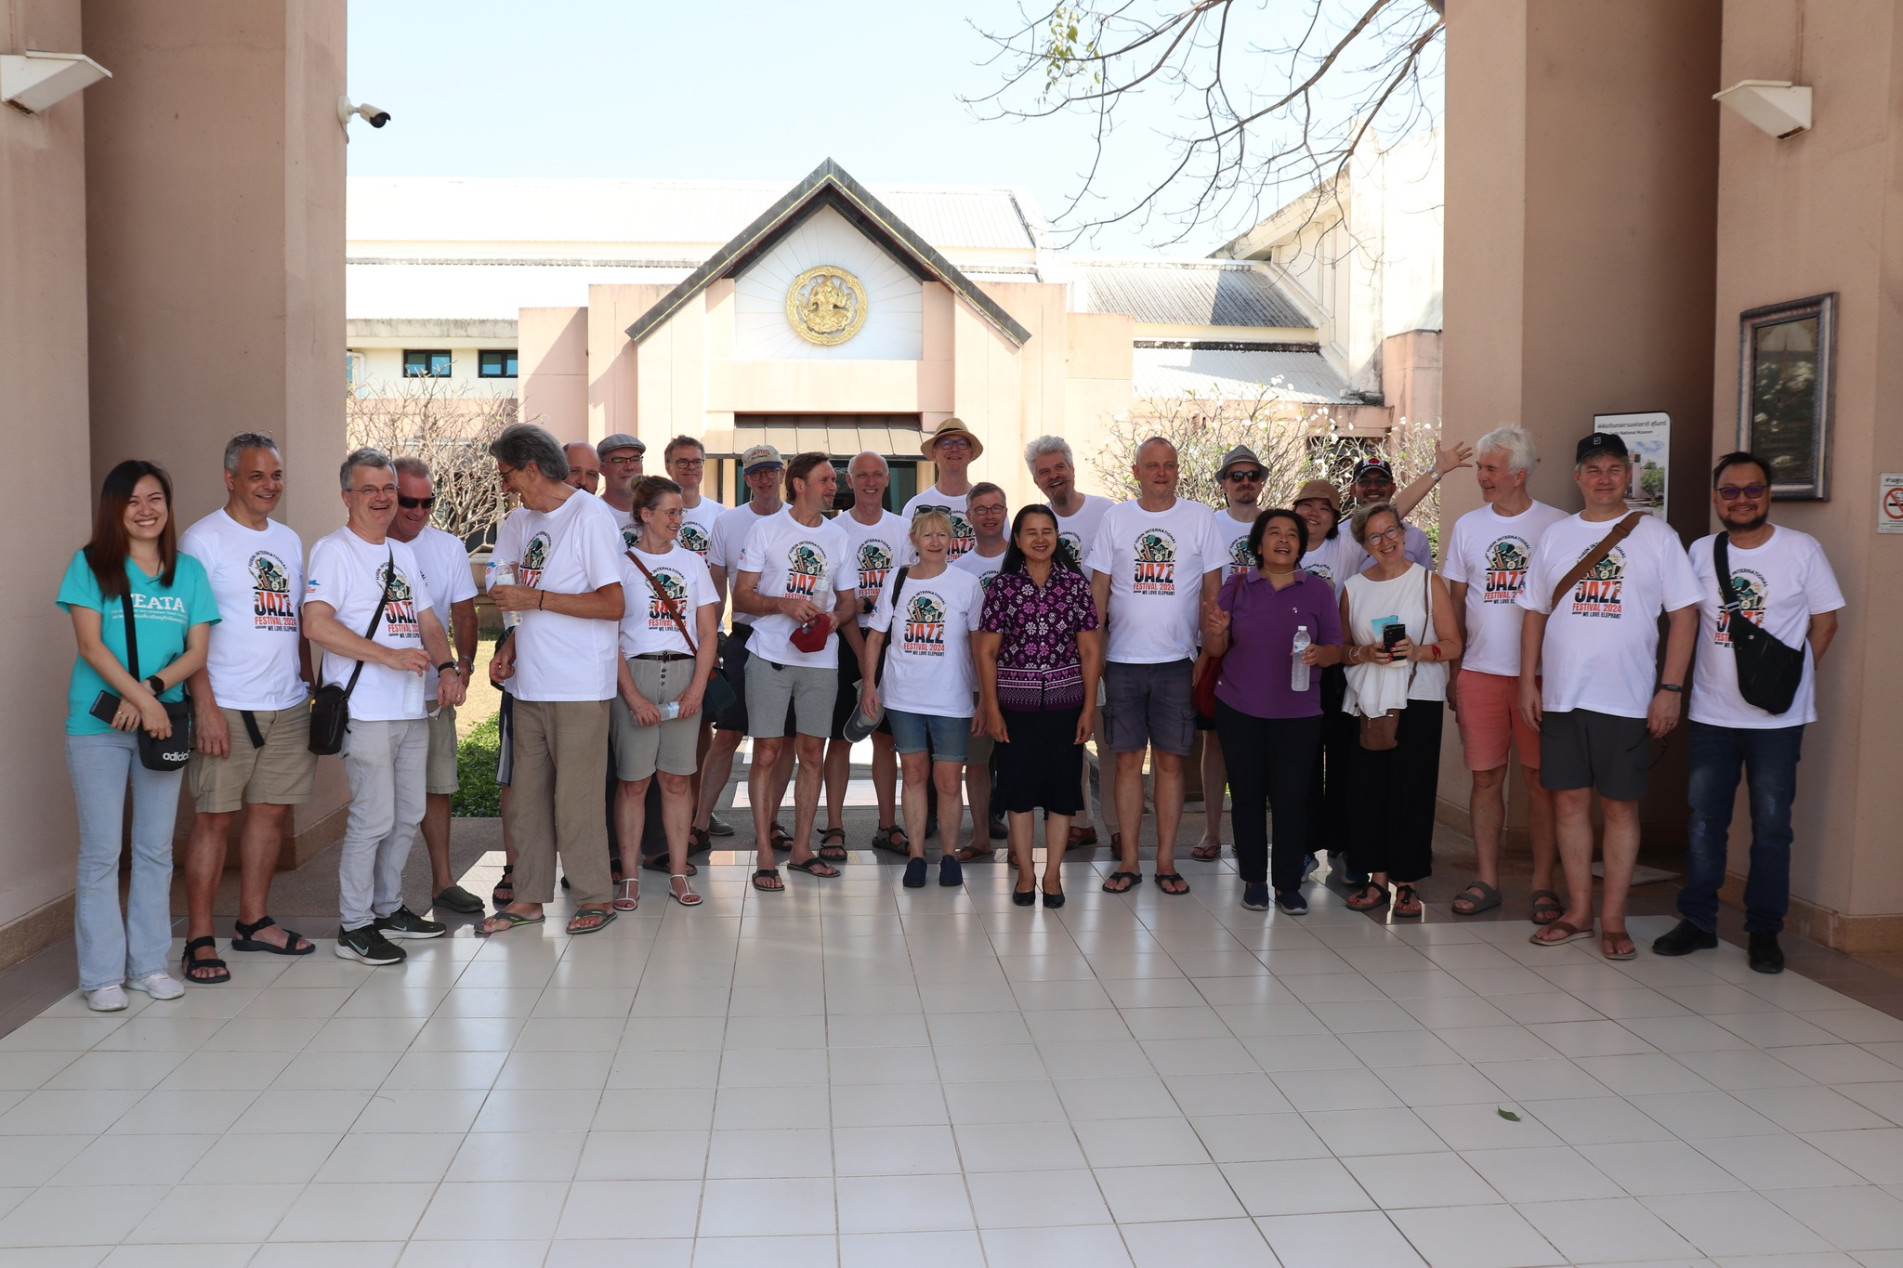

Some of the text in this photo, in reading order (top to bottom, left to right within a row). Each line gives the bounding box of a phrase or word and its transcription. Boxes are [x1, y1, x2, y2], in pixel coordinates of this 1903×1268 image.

[1134, 563, 1175, 584] JAZZ
[1484, 591, 1510, 600] FESTIVAL
[1574, 581, 1623, 604] JAZZ
[121, 593, 186, 614] EATA
[253, 591, 295, 617] JAZZ
[1572, 602, 1622, 613] FESTIVAL 2024
[254, 616, 282, 626] FESTIVAL
[904, 622, 945, 644] JAZZ
[903, 642, 944, 652] FESTIVAL 2024
